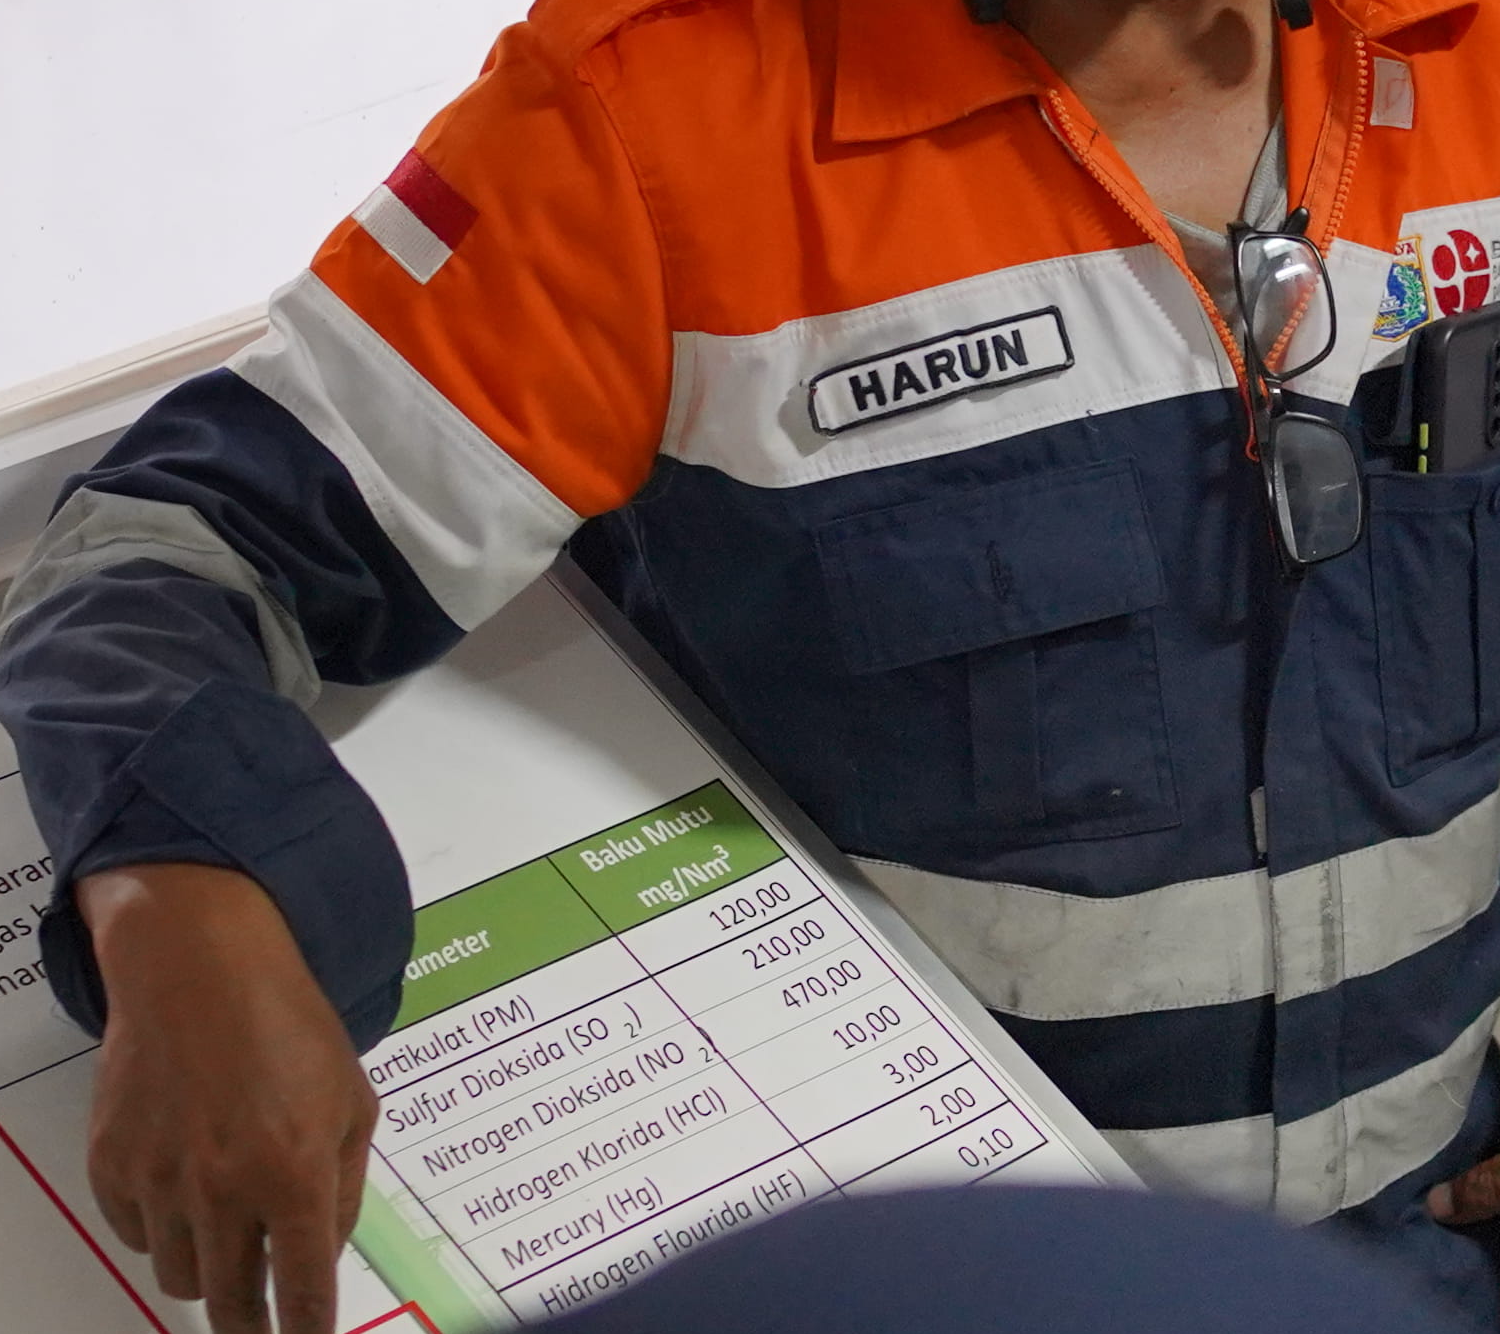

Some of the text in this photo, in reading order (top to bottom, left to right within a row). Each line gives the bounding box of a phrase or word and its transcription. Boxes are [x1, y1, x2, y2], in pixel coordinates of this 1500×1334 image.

[848, 329, 1029, 412] HARUN
[579, 804, 714, 873] Baku Mutu
[369, 880, 792, 1085] artikulat (PM) 120,00
[386, 1084, 458, 1133] Sulfur
[460, 1040, 566, 1100] Dioksida
[741, 917, 826, 971] 210,00
[402, 929, 492, 985] ameter
[422, 1113, 535, 1178] Nitrogen
[532, 1067, 637, 1127] Dioksida
[782, 958, 863, 1010] 470,00
[463, 1003, 902, 1227] Hidrogen Klorida (HCl) 10,00
[499, 1043, 940, 1271] Mercury (Hg) 3,00
[956, 1126, 1016, 1169] 0,10
[539, 1085, 977, 1315] Hidrogen Flourida (HF) 2,00
